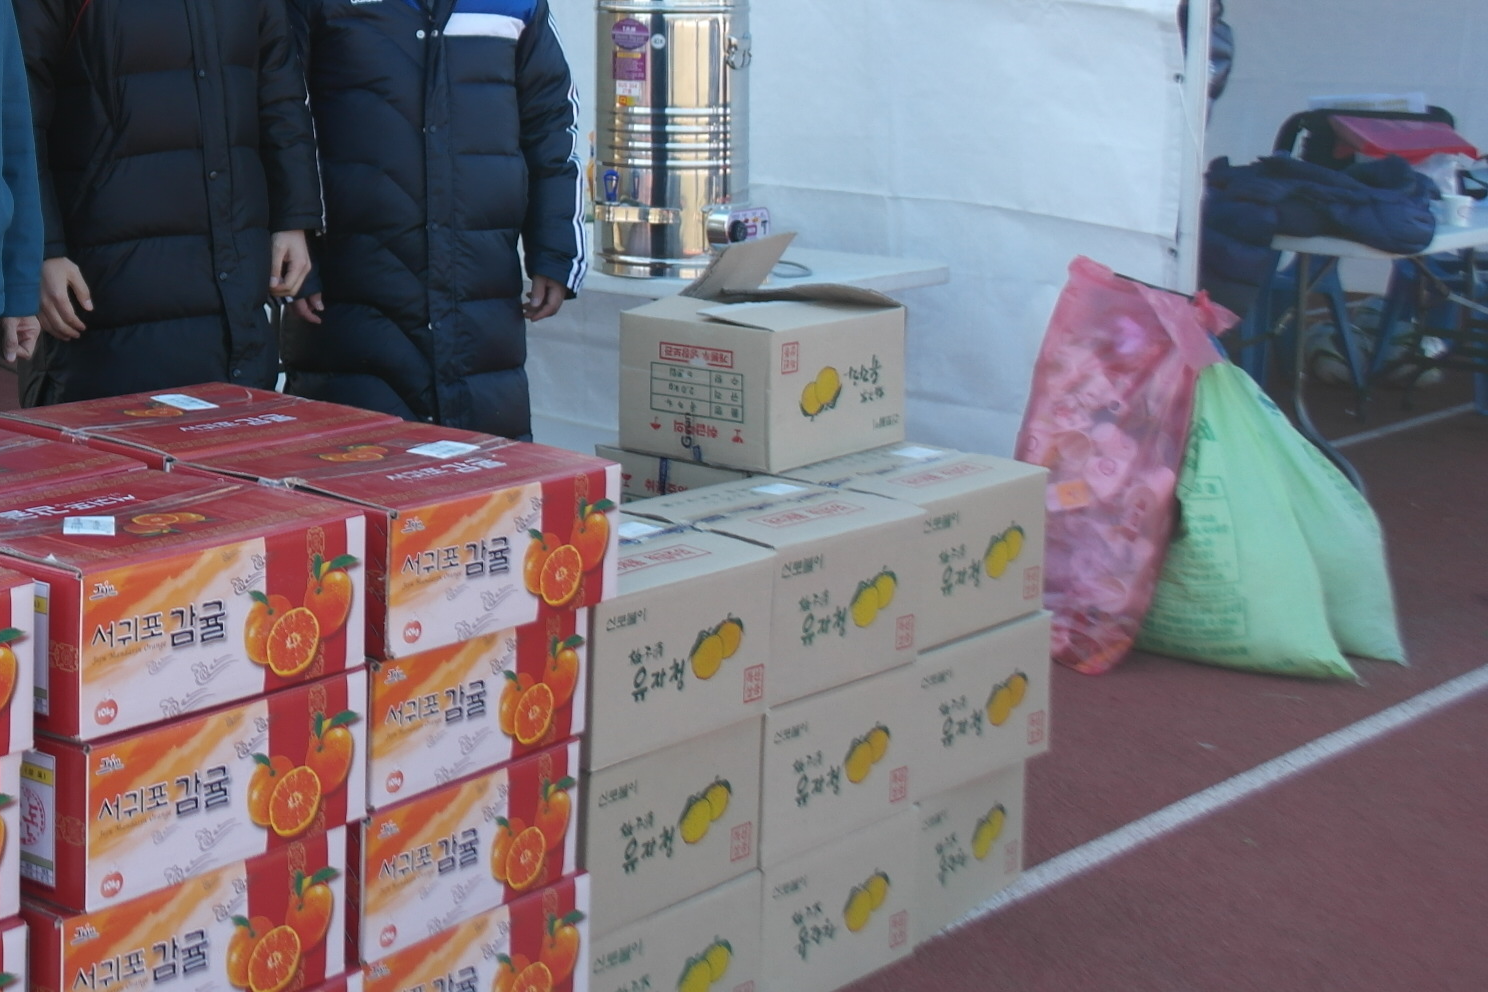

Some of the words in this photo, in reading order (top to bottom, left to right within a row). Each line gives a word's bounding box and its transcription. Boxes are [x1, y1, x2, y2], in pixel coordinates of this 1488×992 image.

[401, 545, 460, 575] 서귀포
[465, 536, 510, 577] 감귤
[91, 611, 164, 648] 서귀포
[170, 599, 227, 648] 감귤
[385, 692, 440, 726] 서귀포
[444, 679, 487, 723] 감귤
[630, 657, 685, 703] 유자청
[98, 781, 169, 821] 서귀포
[174, 764, 230, 816] 감귤
[379, 843, 433, 881] 서귀포
[437, 827, 480, 874] 감귤
[73, 947, 146, 990] 서귀포
[153, 928, 208, 982] 감귤
